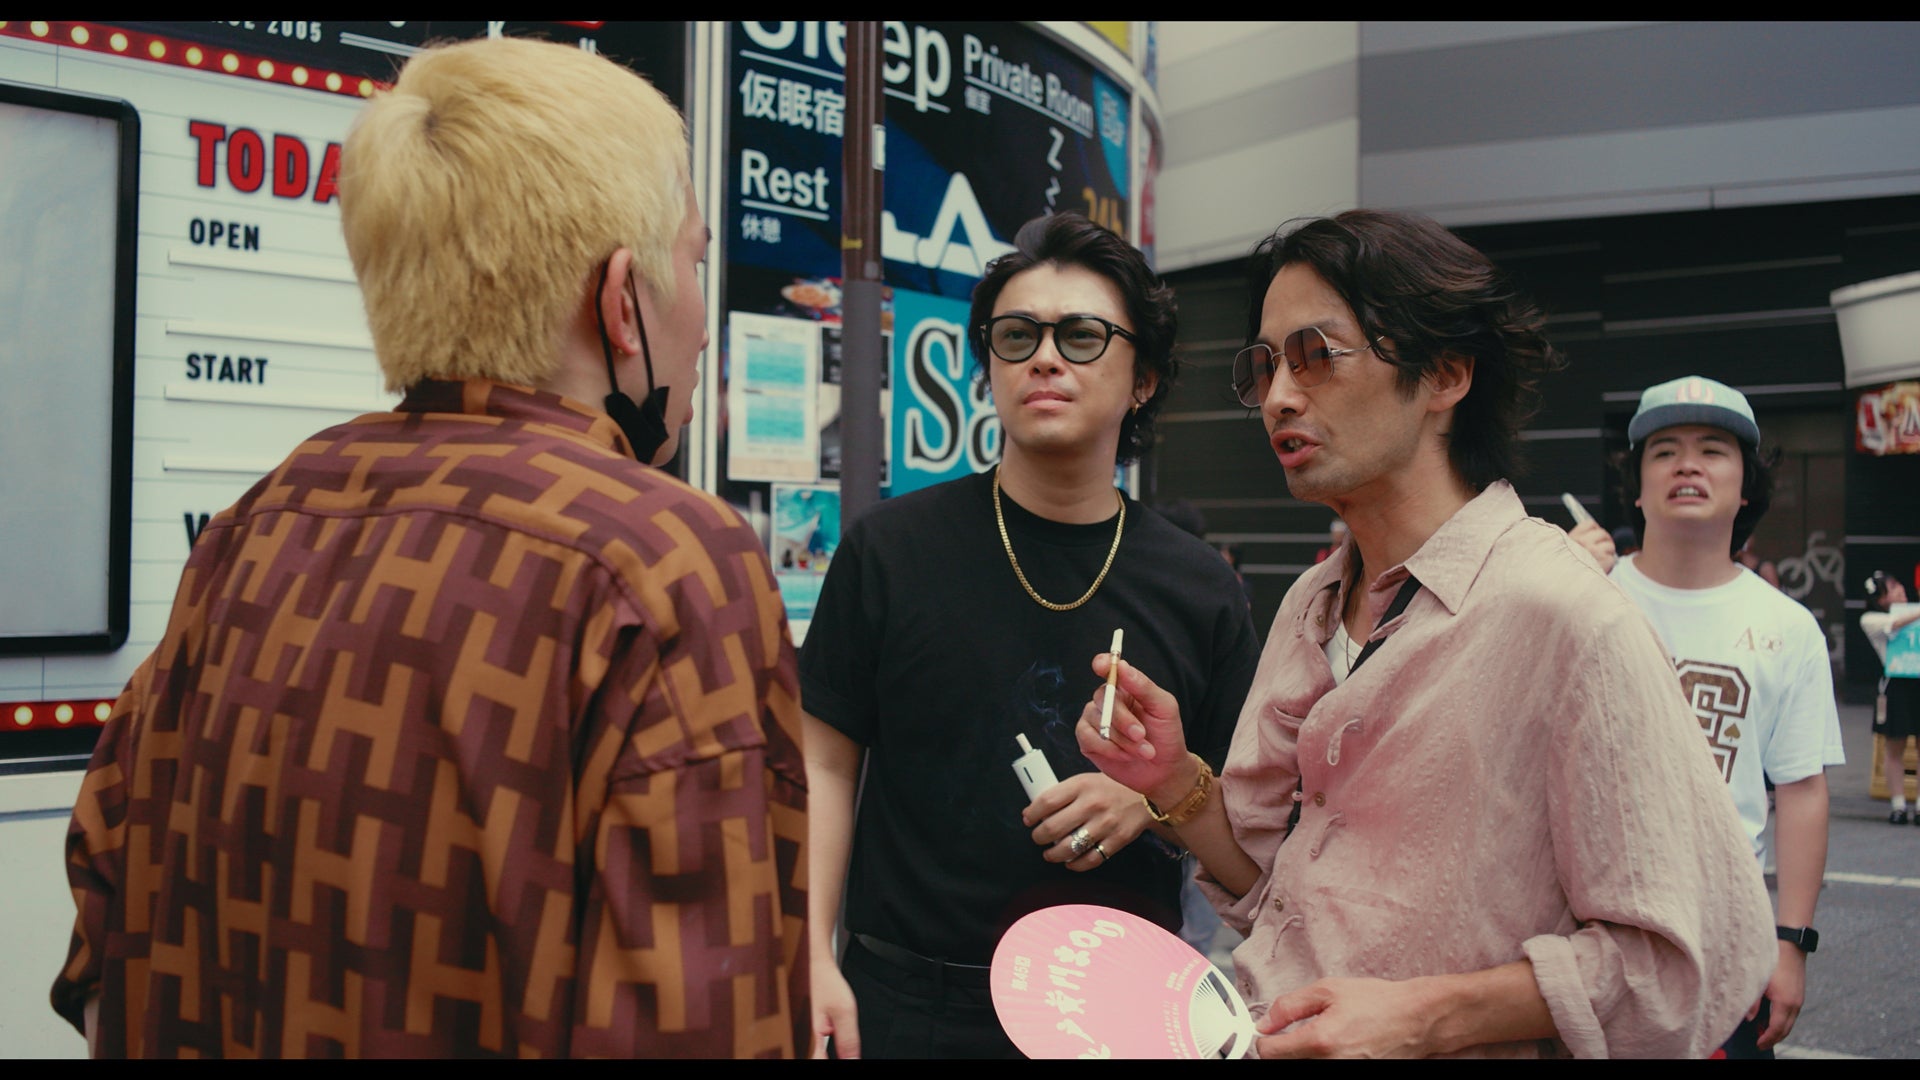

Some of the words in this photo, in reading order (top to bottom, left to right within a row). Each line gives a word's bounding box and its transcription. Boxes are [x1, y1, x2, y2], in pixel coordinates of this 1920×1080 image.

[267, 21, 321, 43] 2005
[739, 69, 845, 138] 仮眠宿
[964, 34, 1043, 104] Private
[1046, 72, 1093, 132] Room
[741, 149, 829, 211] Rest
[190, 218, 259, 252] OPEN
[186, 353, 268, 385] START
